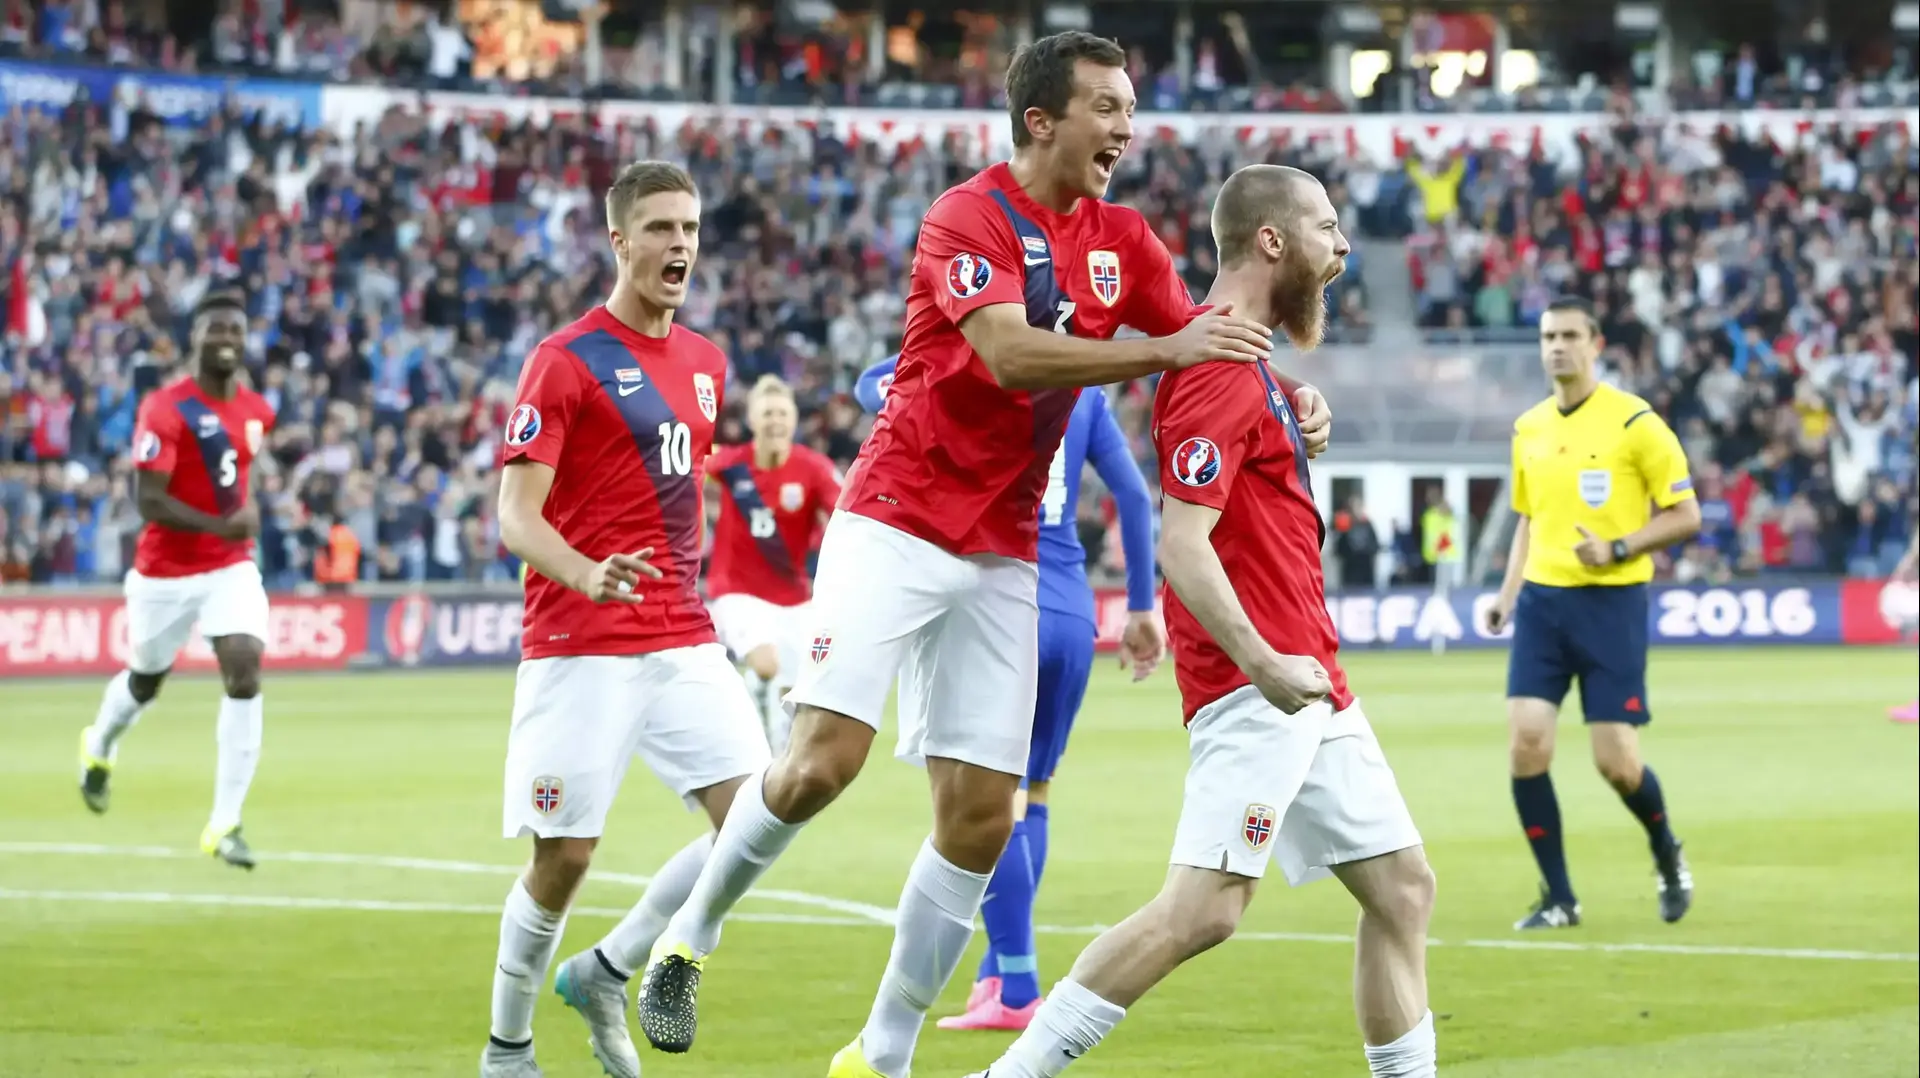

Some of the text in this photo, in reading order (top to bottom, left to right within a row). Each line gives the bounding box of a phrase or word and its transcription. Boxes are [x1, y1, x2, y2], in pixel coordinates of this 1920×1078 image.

[219, 448, 238, 488] 5
[658, 421, 692, 476] 10
[436, 602, 522, 655] UEF
[1657, 587, 1817, 638] 2016
